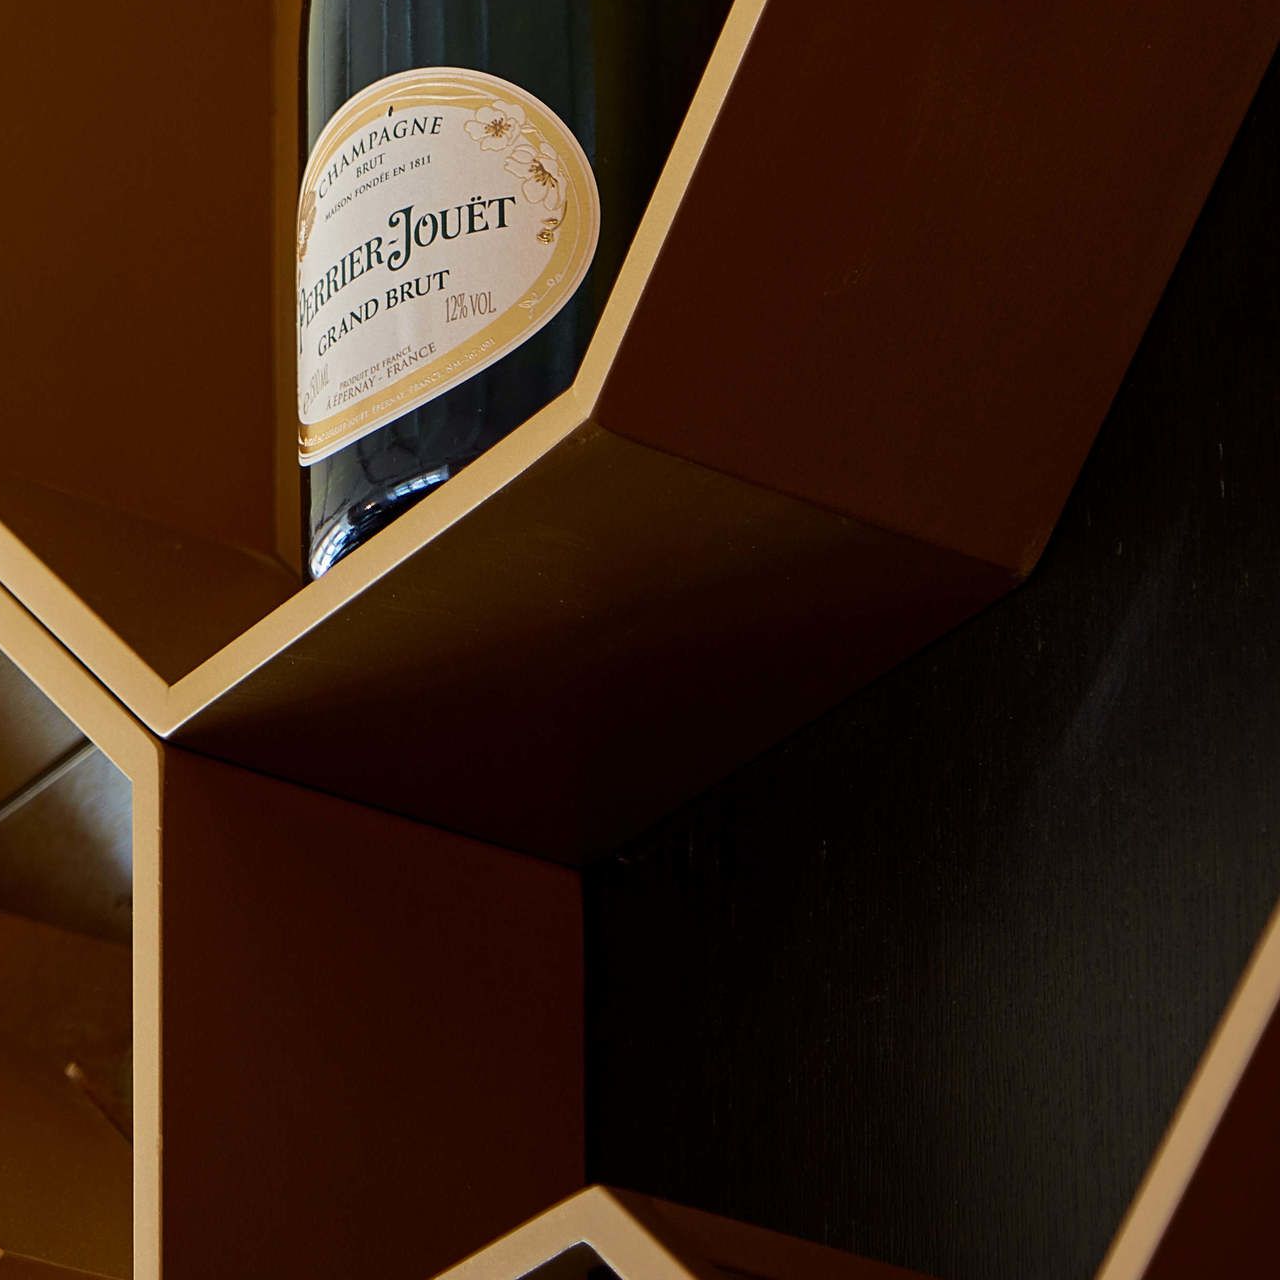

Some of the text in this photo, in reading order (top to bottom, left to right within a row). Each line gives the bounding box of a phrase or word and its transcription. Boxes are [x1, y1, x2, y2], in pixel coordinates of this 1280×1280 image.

[318, 116, 444, 199] CHAMPAGNE
[356, 153, 386, 178] BRUT
[325, 193, 352, 221] MAISON
[392, 164, 406, 177] EN
[411, 154, 431, 169] 1811
[317, 269, 450, 357] GRAND BRUT
[445, 291, 497, 323] 12% VOL
[340, 345, 412, 389] PRODUIT DE FRANCE
[386, 342, 437, 378] FRANCE
